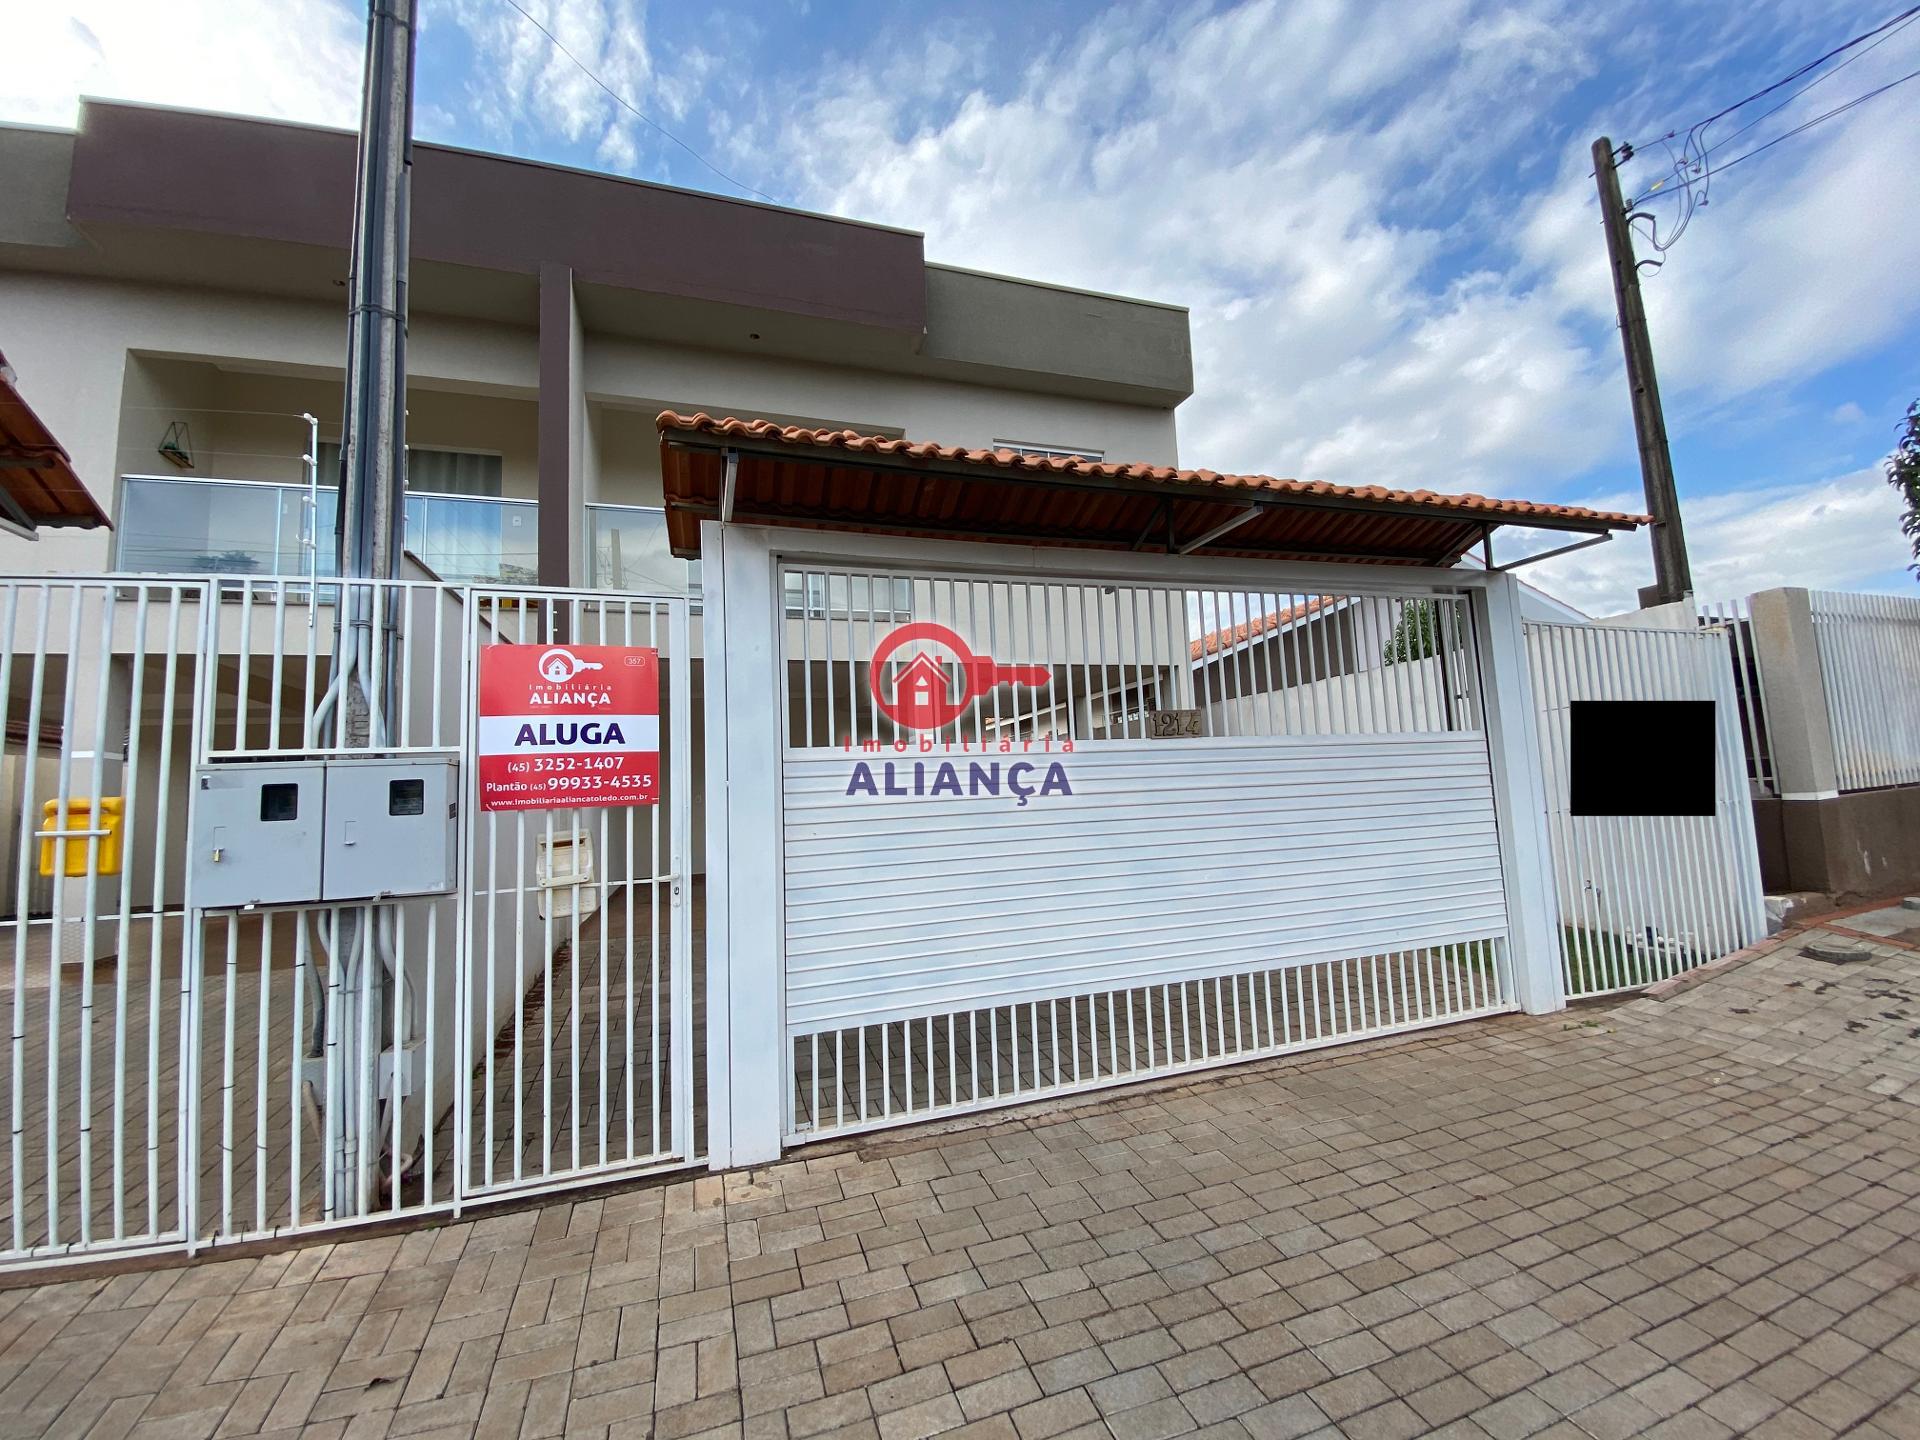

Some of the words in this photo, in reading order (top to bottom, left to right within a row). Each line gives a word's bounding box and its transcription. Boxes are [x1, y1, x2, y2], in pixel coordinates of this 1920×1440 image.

[529, 692, 611, 707] ALIANÇA
[514, 723, 626, 746] ALUGA
[507, 762, 530, 773] (45)
[534, 757, 625, 771] 3252-1407
[486, 782, 527, 792] Plantão
[530, 783, 546, 791] (45)
[548, 775, 652, 790] 99933-4535
